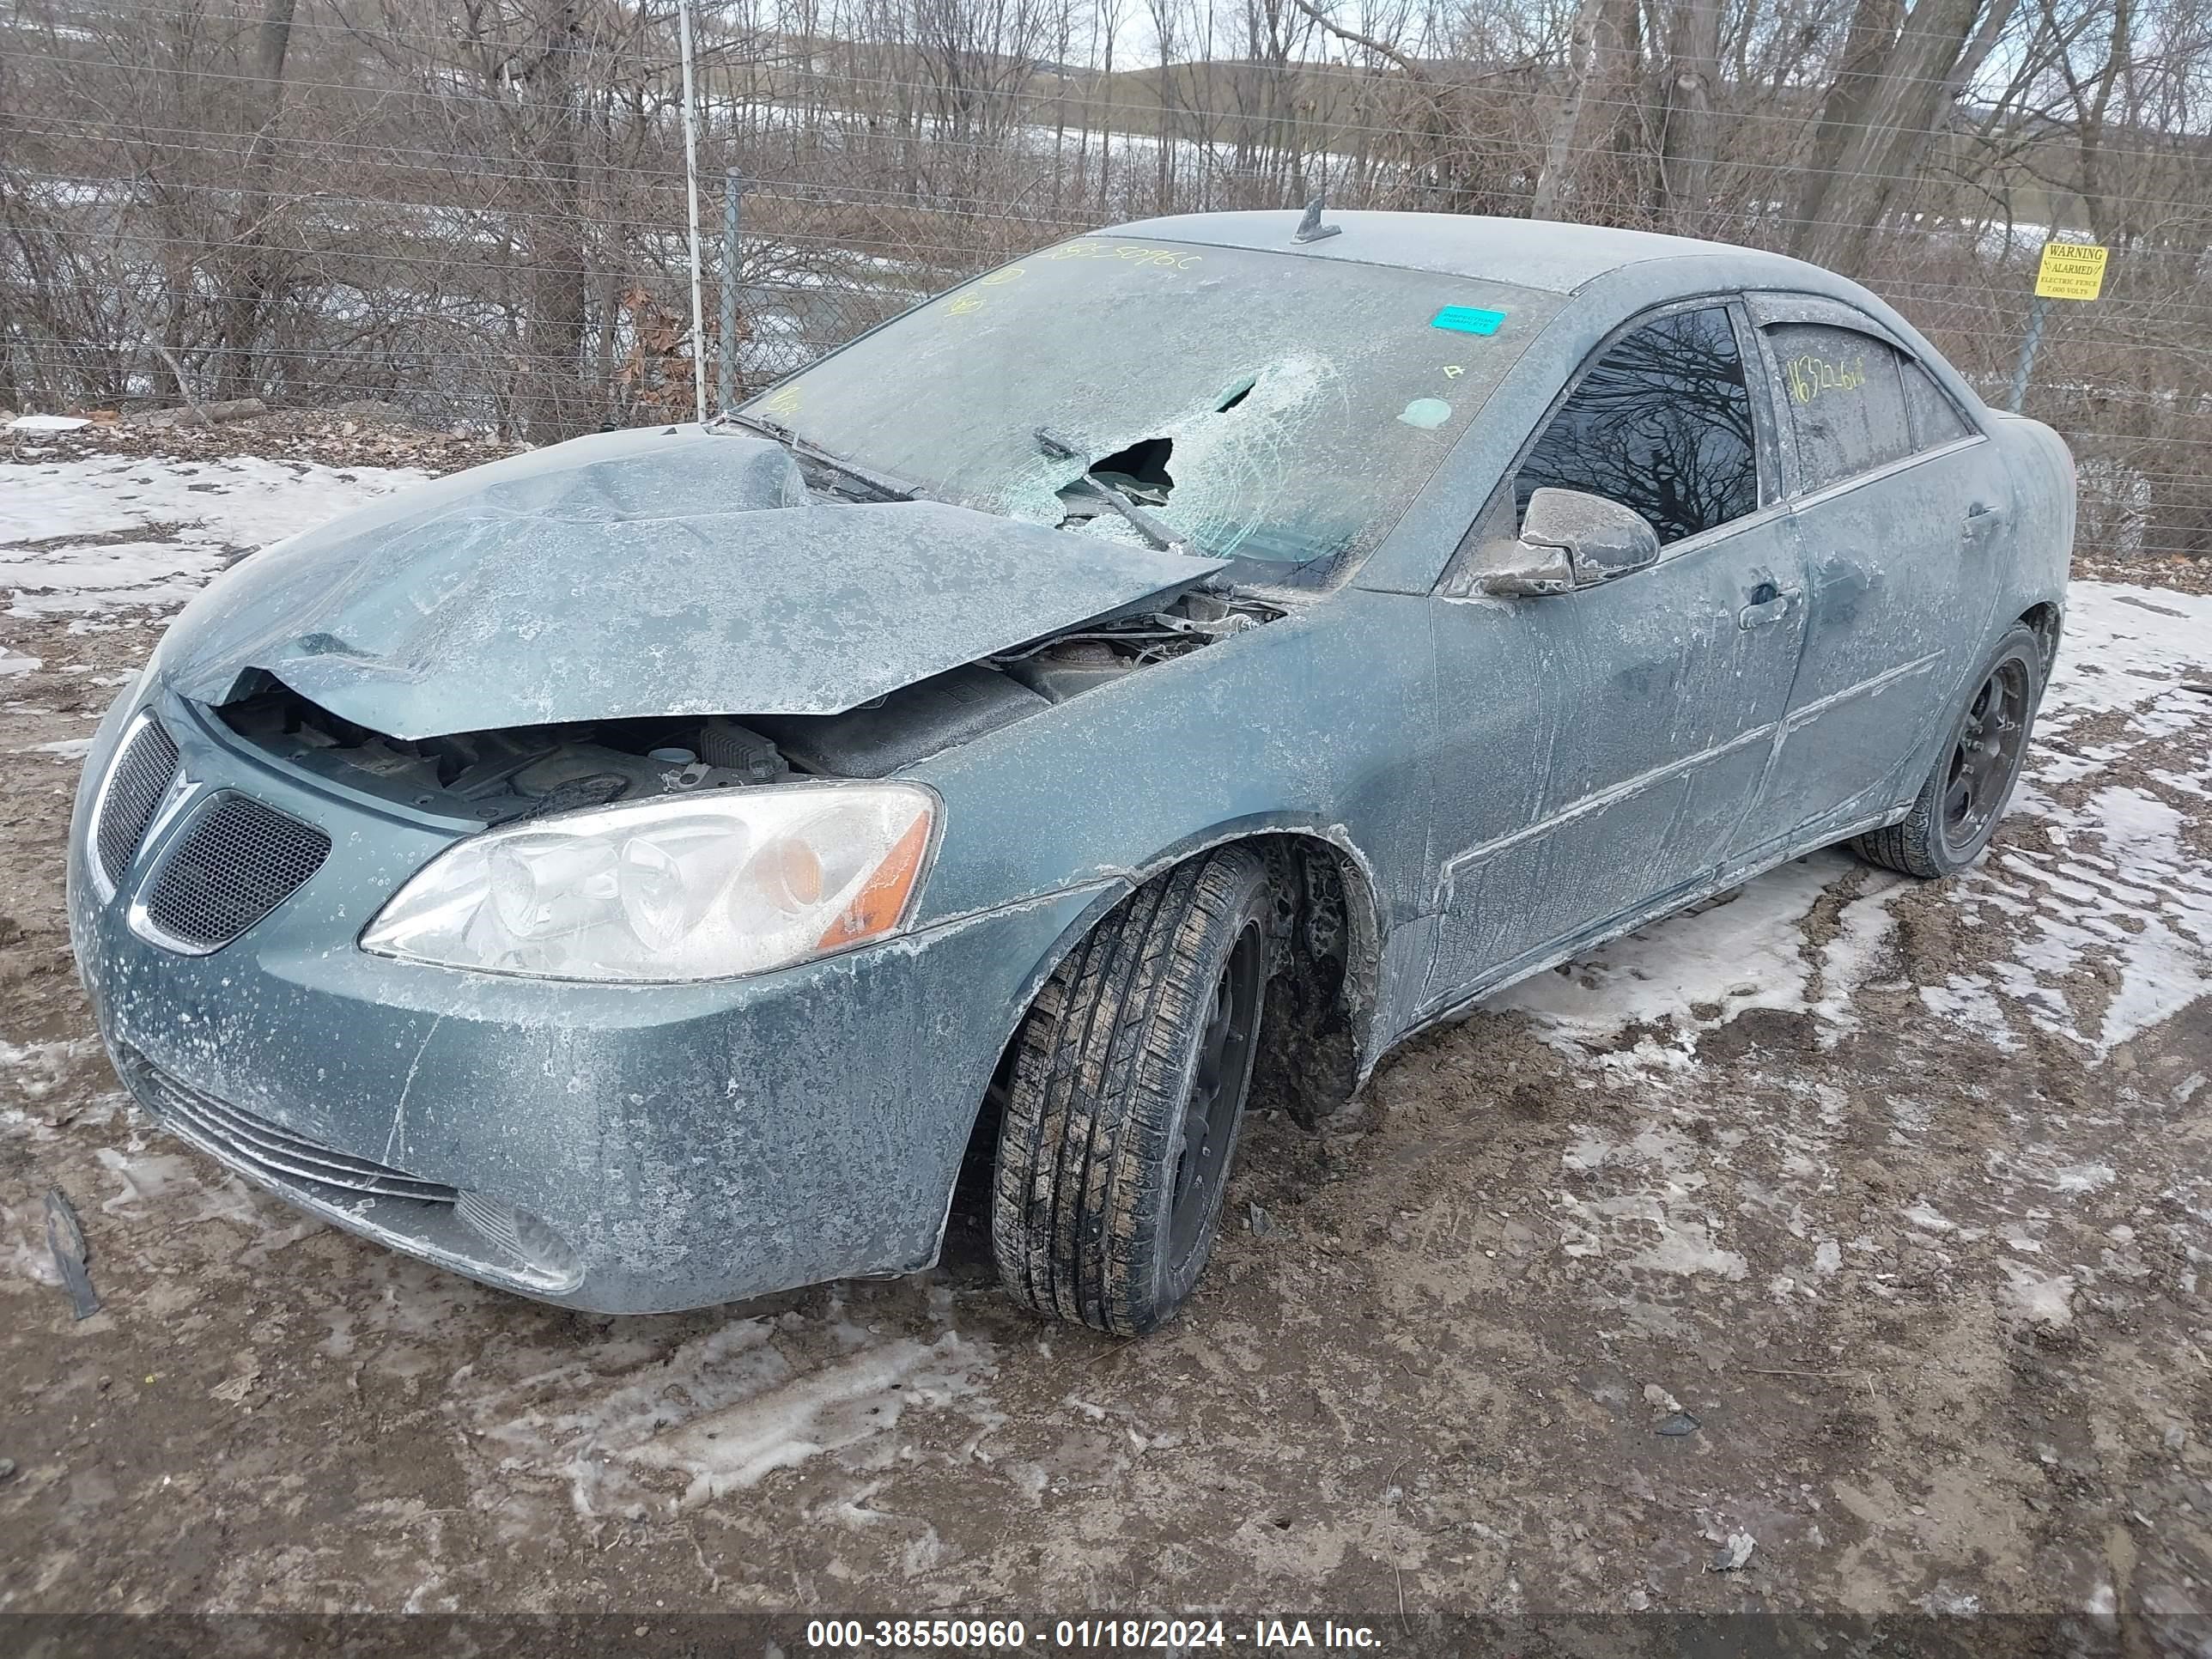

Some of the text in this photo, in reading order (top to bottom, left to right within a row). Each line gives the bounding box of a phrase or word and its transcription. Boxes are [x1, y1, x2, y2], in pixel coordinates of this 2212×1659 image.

[2050, 245, 2103, 260] WARNING
[2051, 263, 2093, 276] ALARMED
[2040, 276, 2098, 288] ELECTRIC FENCE
[1443, 313, 1494, 324] INSPECTION
[1443, 318, 1489, 327] COMPLETE
